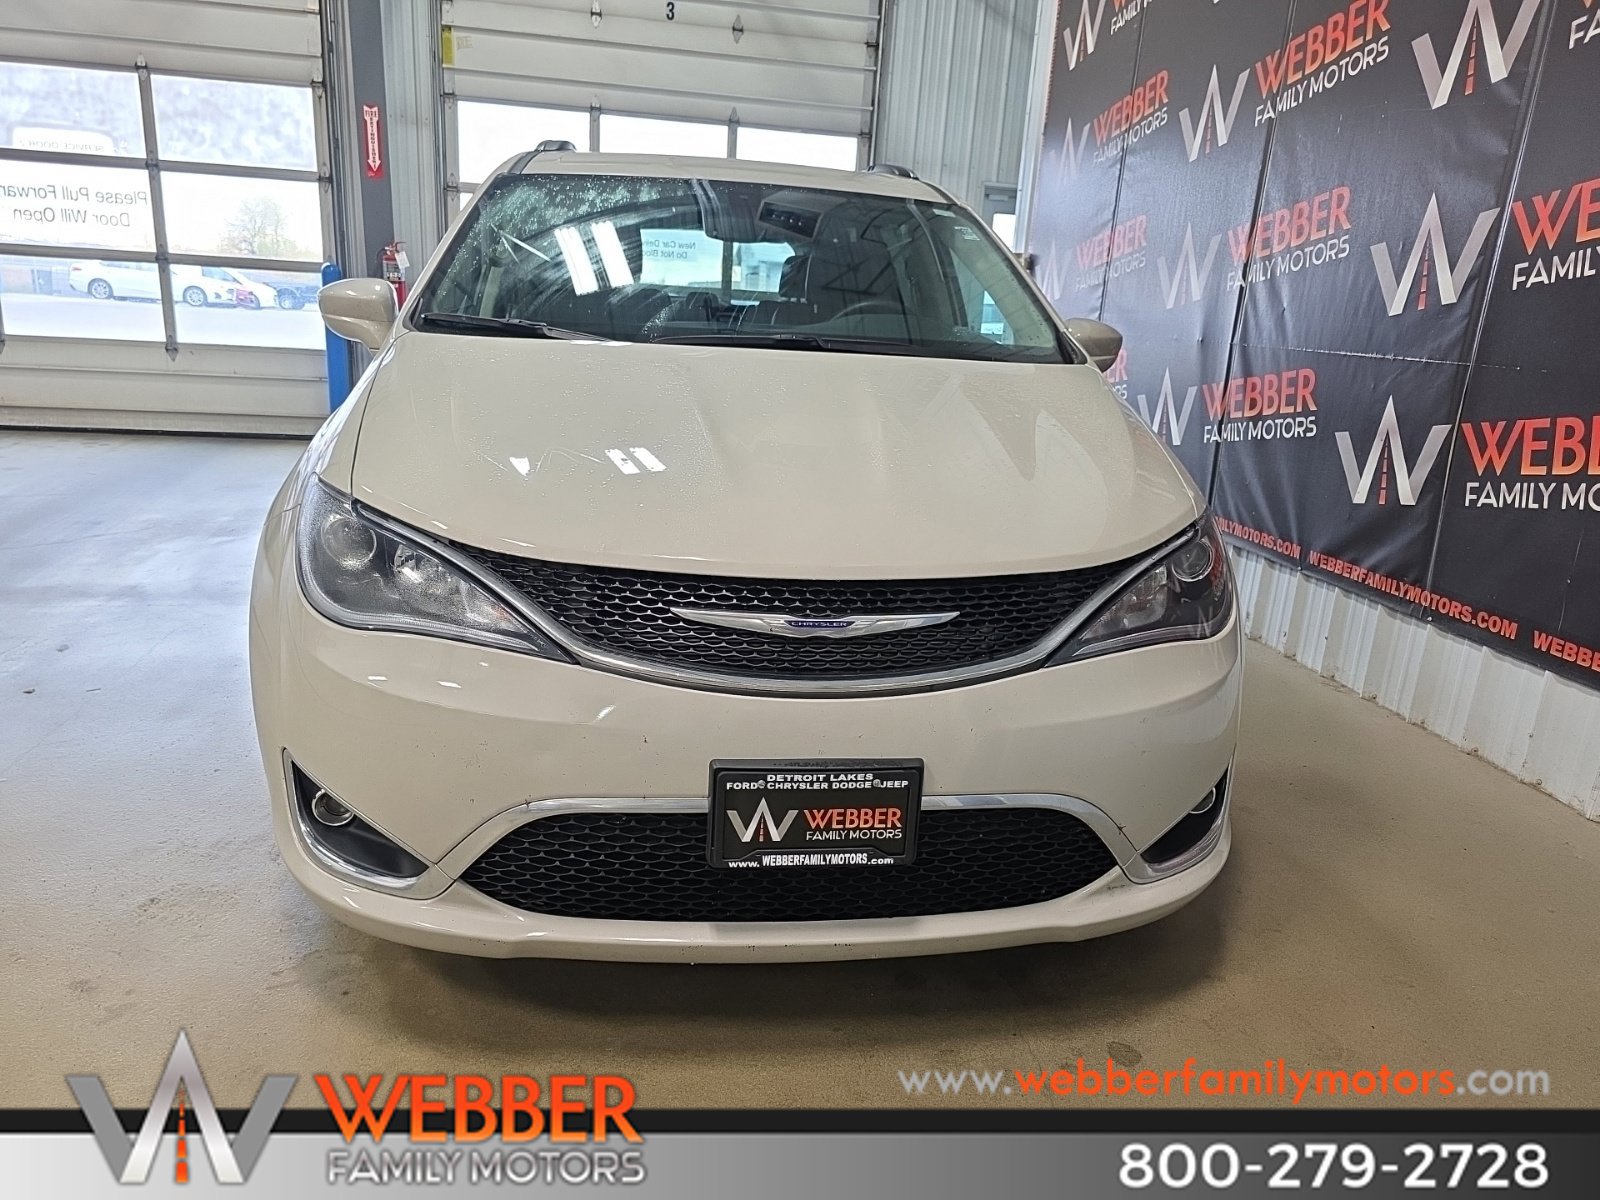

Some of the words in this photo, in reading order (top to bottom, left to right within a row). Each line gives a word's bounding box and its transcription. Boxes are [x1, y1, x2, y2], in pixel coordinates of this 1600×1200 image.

[666, 1, 675, 20] 3
[1255, 0, 1391, 100] WEBBER
[1093, 70, 1169, 147] WEBBER
[1254, 80, 1308, 127] FAMILY
[1309, 36, 1389, 98] MOTORS
[1076, 215, 1148, 270] WEBBER
[1227, 186, 1352, 267] WEBBER
[1226, 259, 1275, 291] FAMILY
[1276, 235, 1350, 276] MOTORS
[1202, 368, 1318, 422] WEBBER
[1203, 422, 1247, 444] FAMILY
[1248, 416, 1317, 441] MOTORS
[1464, 481, 1557, 510] FAMILY
[1309, 550, 1518, 640] WEBBERFAMILYMOTORS.COM
[726, 782, 759, 790] FORD
[768, 782, 829, 790] CHRYSLER
[832, 781, 872, 789] DODGE
[880, 780, 909, 789] JEEP
[766, 774, 827, 782] DETROIT
[830, 773, 874, 781] LAKES
[803, 808, 902, 829] WEBBER
[805, 830, 848, 841] FAMILY
[849, 829, 902, 839] MOTORS
